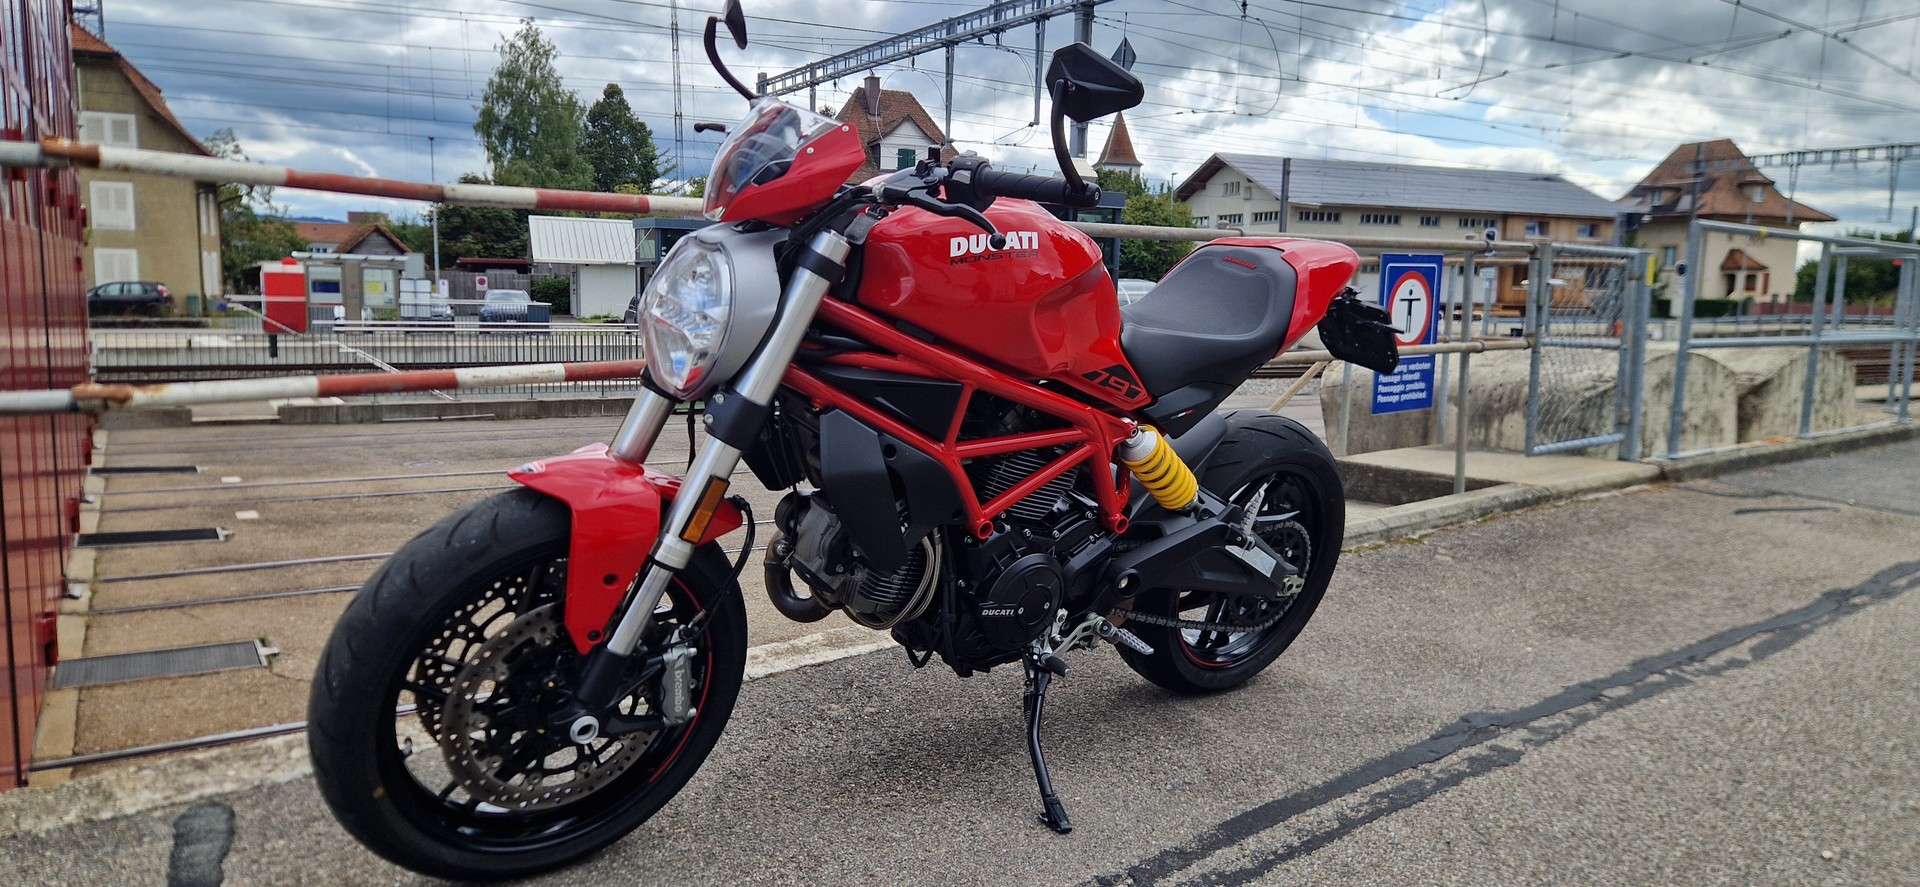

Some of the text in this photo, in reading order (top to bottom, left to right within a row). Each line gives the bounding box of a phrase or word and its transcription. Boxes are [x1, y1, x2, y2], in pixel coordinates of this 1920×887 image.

[950, 251, 1039, 266] MONSTER
[1394, 362, 1431, 374] gang verboten
[1379, 372, 1420, 384] Passage interdit
[1082, 369, 1148, 402] 797
[1378, 381, 1426, 394] Passaggio proibito
[1377, 391, 1427, 404] Passage prohibited
[674, 668, 686, 713] brembo
